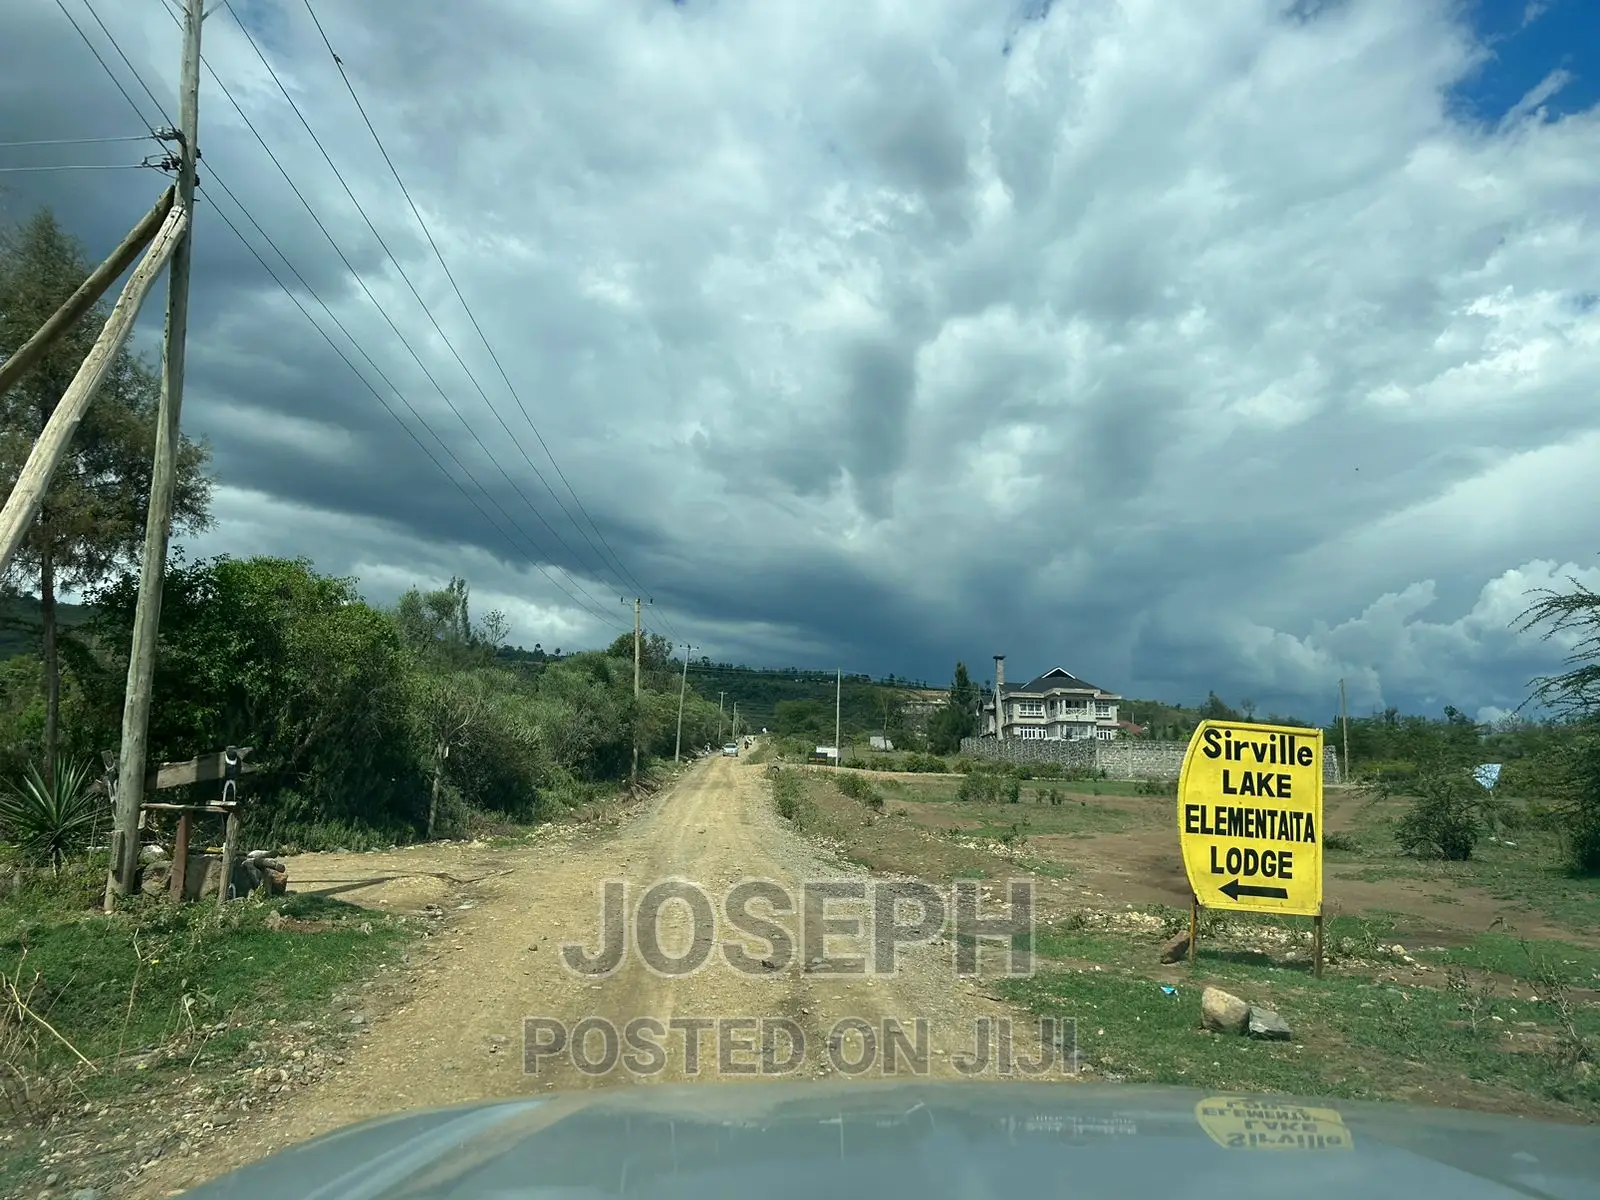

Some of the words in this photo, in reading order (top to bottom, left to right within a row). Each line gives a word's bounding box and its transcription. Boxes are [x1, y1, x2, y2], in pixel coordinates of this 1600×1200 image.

[1202, 727, 1313, 767] Sirville
[1222, 769, 1292, 799] LAKE
[1185, 804, 1316, 844] ELEMENTAITA
[1210, 845, 1293, 879] LODGE
